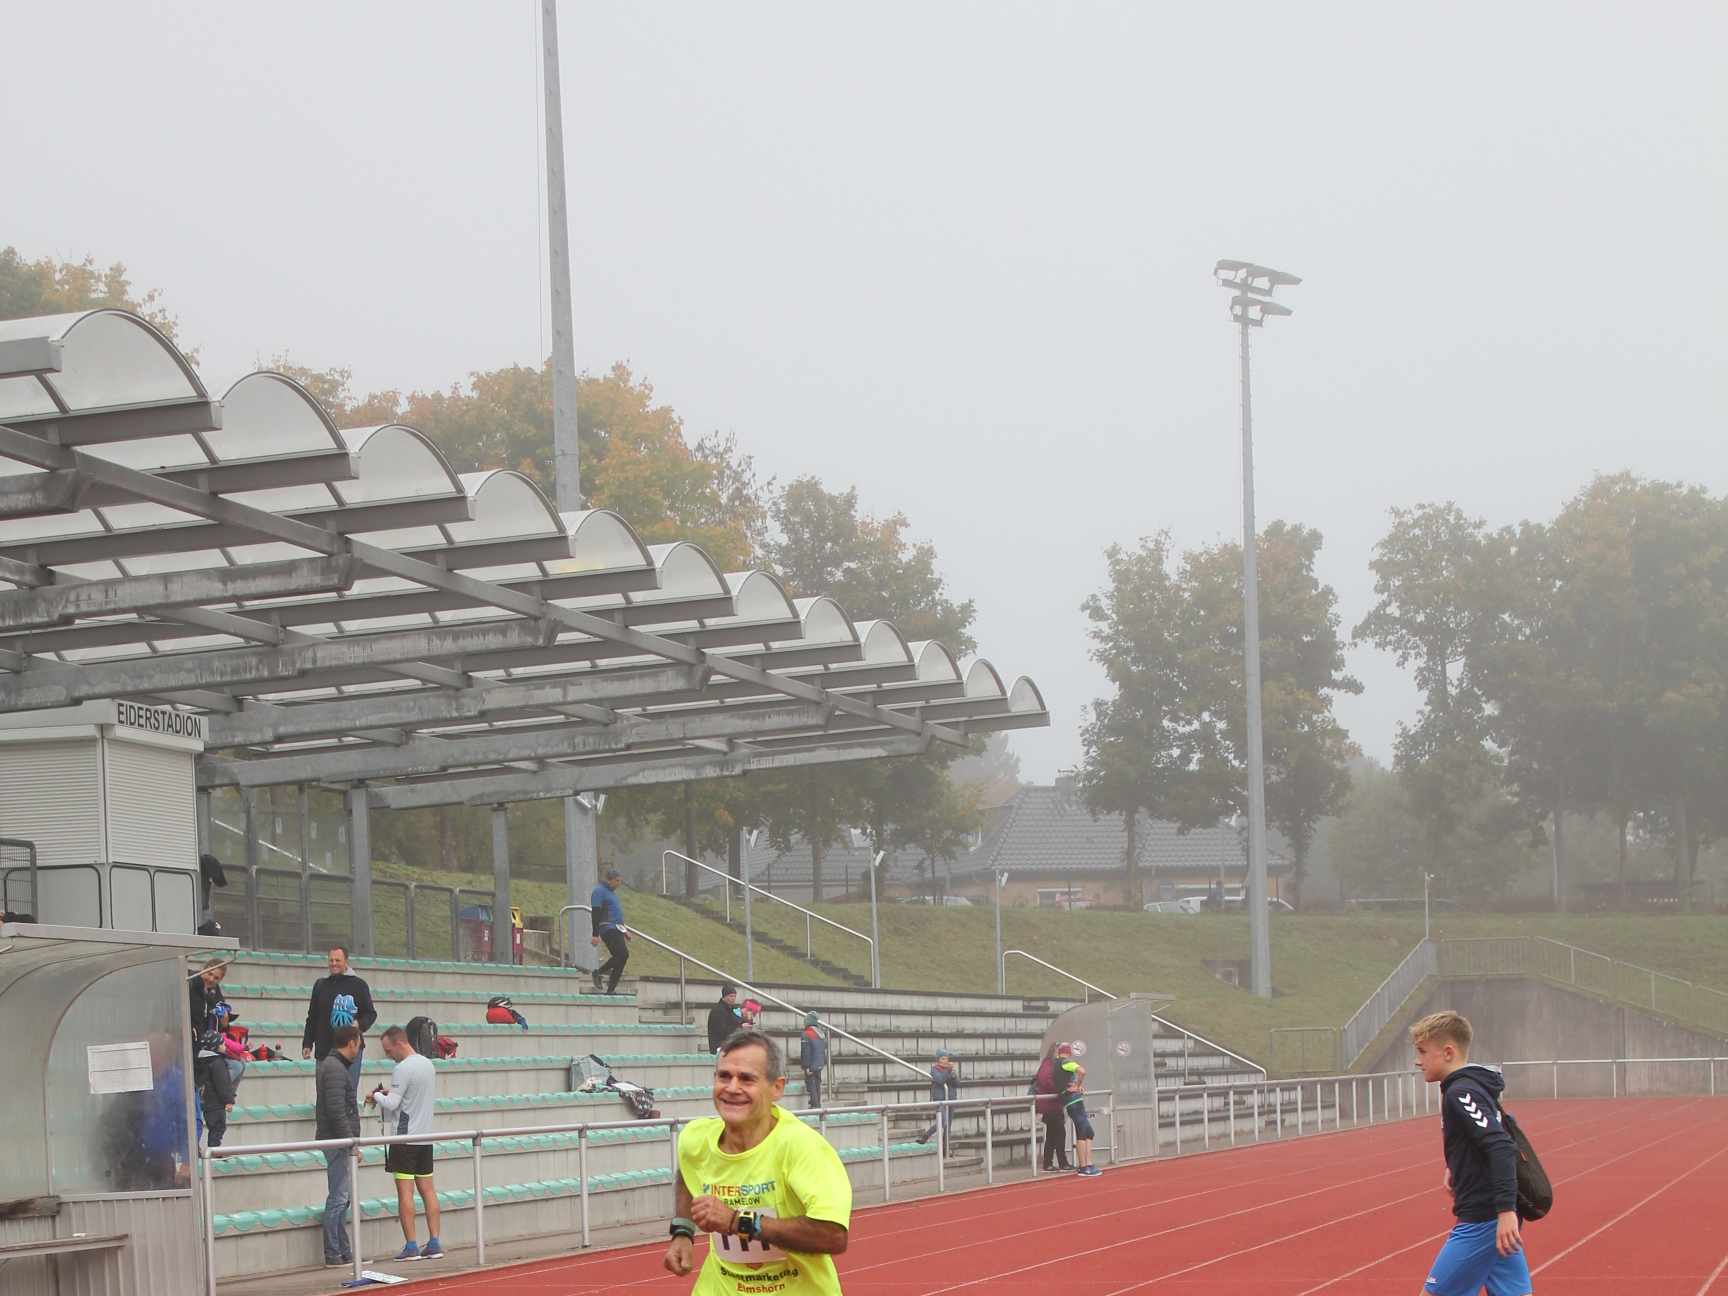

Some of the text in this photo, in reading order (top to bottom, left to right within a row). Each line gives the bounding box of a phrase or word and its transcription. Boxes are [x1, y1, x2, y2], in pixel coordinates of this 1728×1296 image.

[117, 702, 202, 738] EIDERSTADION
[711, 1181, 777, 1196] INTERSPORT
[737, 1282, 785, 1293] Elmshorn
